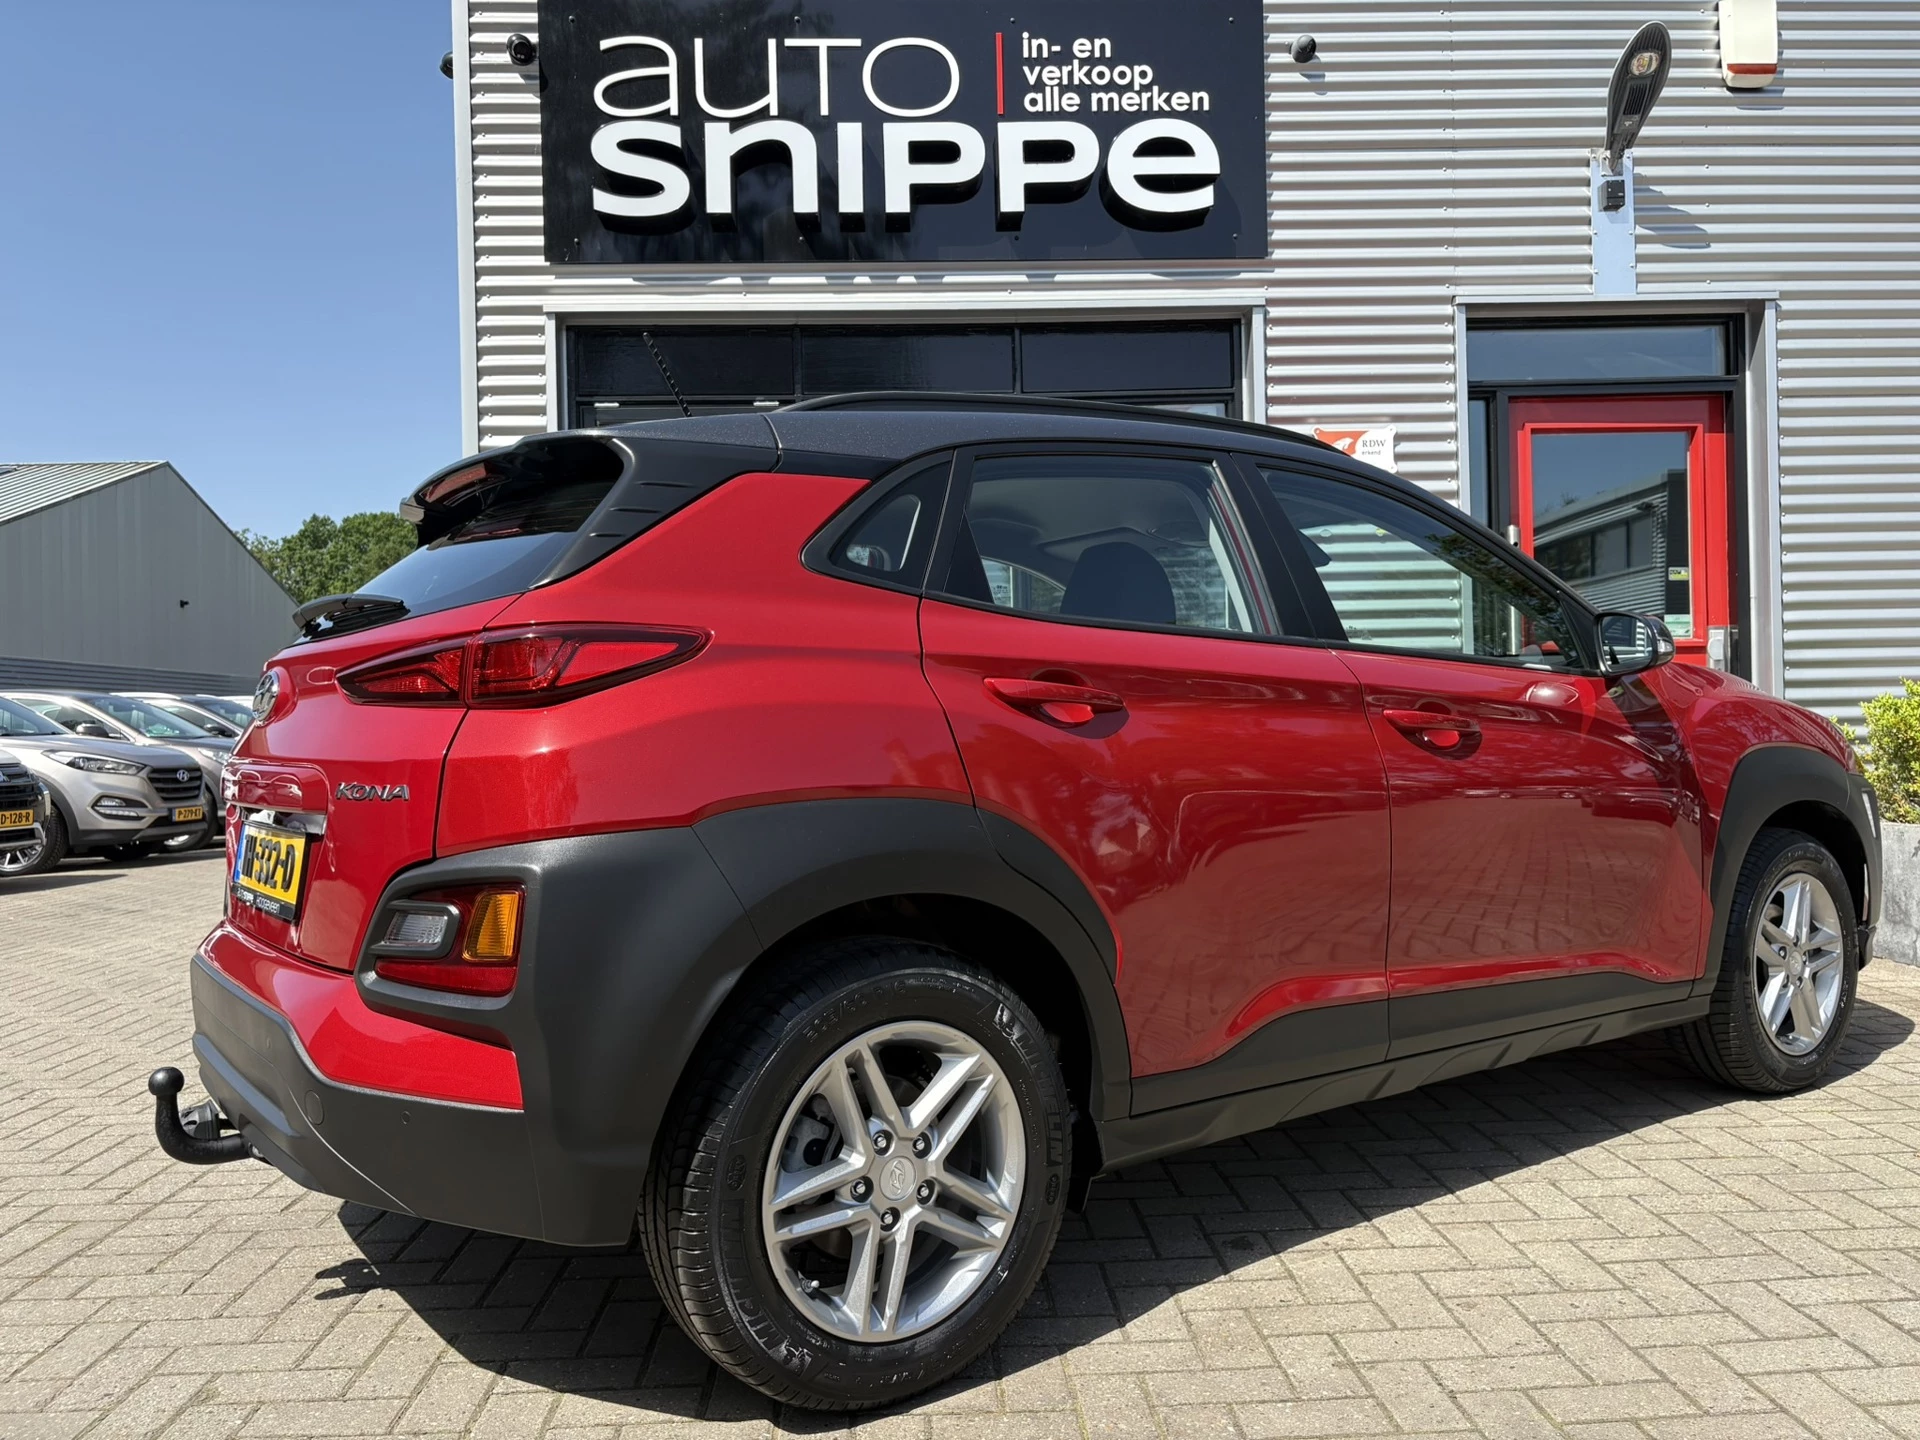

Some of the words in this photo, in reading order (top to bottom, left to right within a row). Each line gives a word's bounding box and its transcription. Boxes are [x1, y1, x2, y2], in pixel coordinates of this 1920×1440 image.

[1022, 32, 1061, 58] in-
[1072, 37, 1112, 58] en
[1022, 59, 1153, 91] verkoop
[1023, 86, 1081, 112] alle
[1090, 85, 1210, 112] merken
[1362, 439, 1386, 447] RDW
[336, 782, 409, 801] KONA
